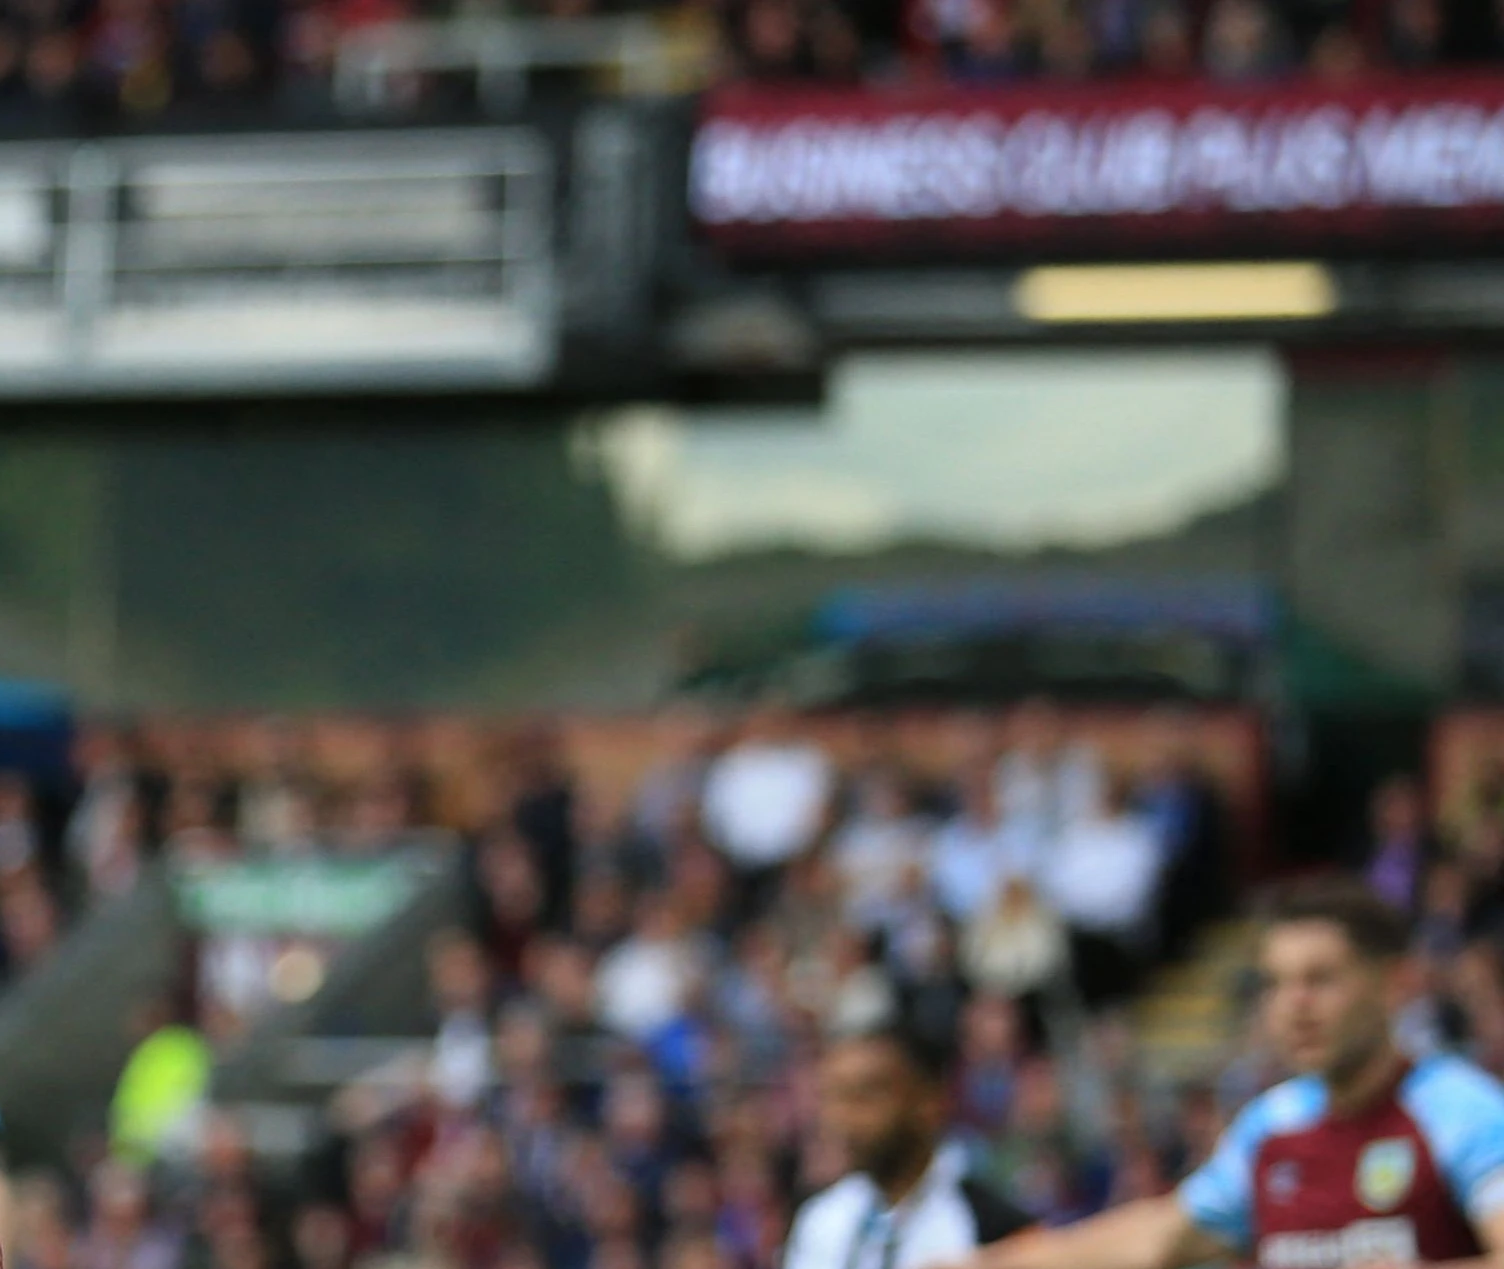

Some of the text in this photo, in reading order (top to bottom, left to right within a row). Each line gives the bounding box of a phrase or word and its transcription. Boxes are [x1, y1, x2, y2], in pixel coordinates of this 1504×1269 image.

[694, 116, 999, 221] BUSINESS
[1002, 110, 1176, 214] CLUB
[1179, 107, 1352, 211] PLUS
